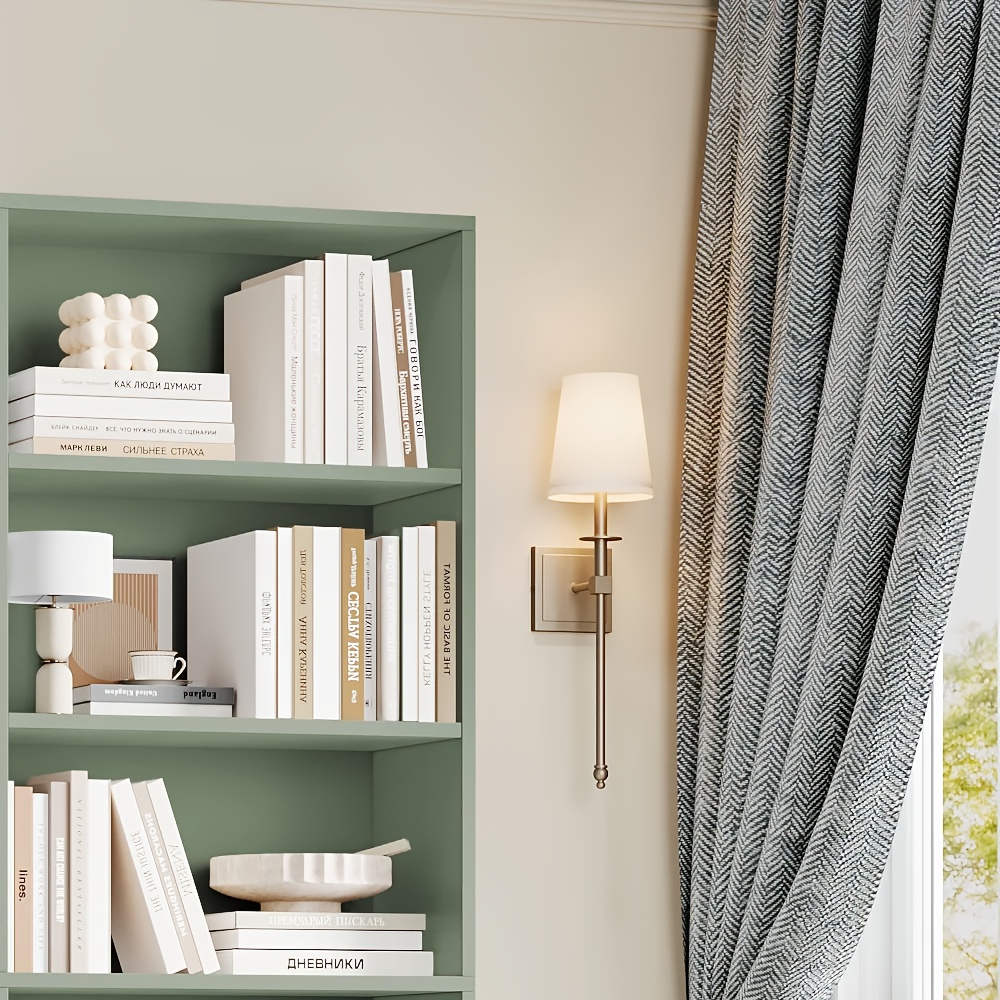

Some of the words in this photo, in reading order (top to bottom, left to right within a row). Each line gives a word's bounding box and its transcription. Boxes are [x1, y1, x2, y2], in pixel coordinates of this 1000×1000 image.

[353, 344, 367, 382] Братья
[408, 338, 421, 391] ГОВОРИ
[114, 380, 131, 389] КАК
[133, 381, 161, 391] ЛЮДИ
[163, 381, 203, 393] ДУМАЮТ
[290, 355, 298, 404] Маленькие
[397, 370, 410, 420] Бархатная
[413, 395, 423, 415] КАК
[72, 424, 99, 432] СНАЙДЕР
[289, 406, 298, 448] женщины
[353, 385, 367, 452] Карамазовы
[401, 422, 412, 455] смерть
[415, 420, 425, 440] БОГ
[60, 443, 84, 452] МАРК
[84, 444, 108, 453] ЛЕВИ
[122, 445, 167, 455] СИЛЬНЕЕ
[170, 446, 204, 457] СТРАХА
[387, 586, 397, 662] architecture
[104, 688, 134, 697] Kingdom
[134, 689, 158, 698] United
[183, 689, 217, 700] England
[18, 869, 28, 902] lines.
[287, 958, 364, 970] ДНЕВНИКИ
